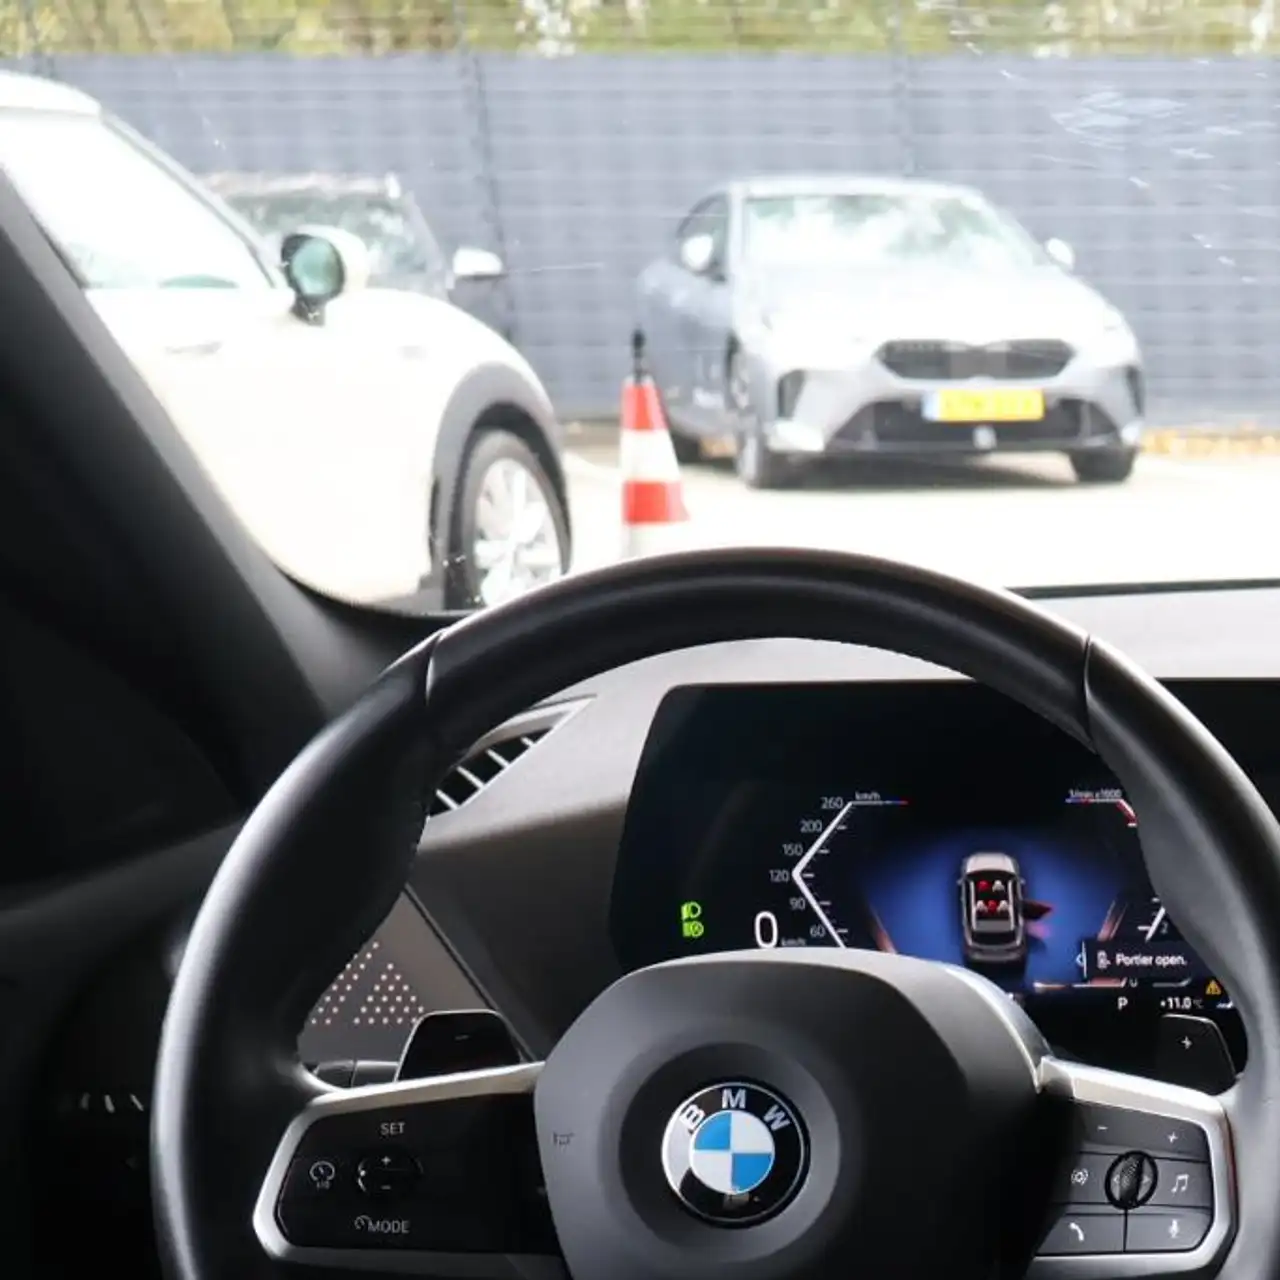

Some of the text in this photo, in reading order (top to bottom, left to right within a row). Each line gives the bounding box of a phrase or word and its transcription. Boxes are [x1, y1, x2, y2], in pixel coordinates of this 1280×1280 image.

[821, 797, 844, 810] 260
[800, 820, 823, 833] 200
[782, 844, 804, 857] 150
[769, 870, 790, 883] 120
[789, 897, 806, 911] 90
[754, 911, 779, 948] 0
[809, 925, 827, 938] 60
[1116, 953, 1188, 970] Portier open.
[1118, 997, 1129, 1010] P
[680, 1088, 791, 1132] BMW
[380, 1122, 406, 1136] SET
[367, 1220, 411, 1235] MODE
